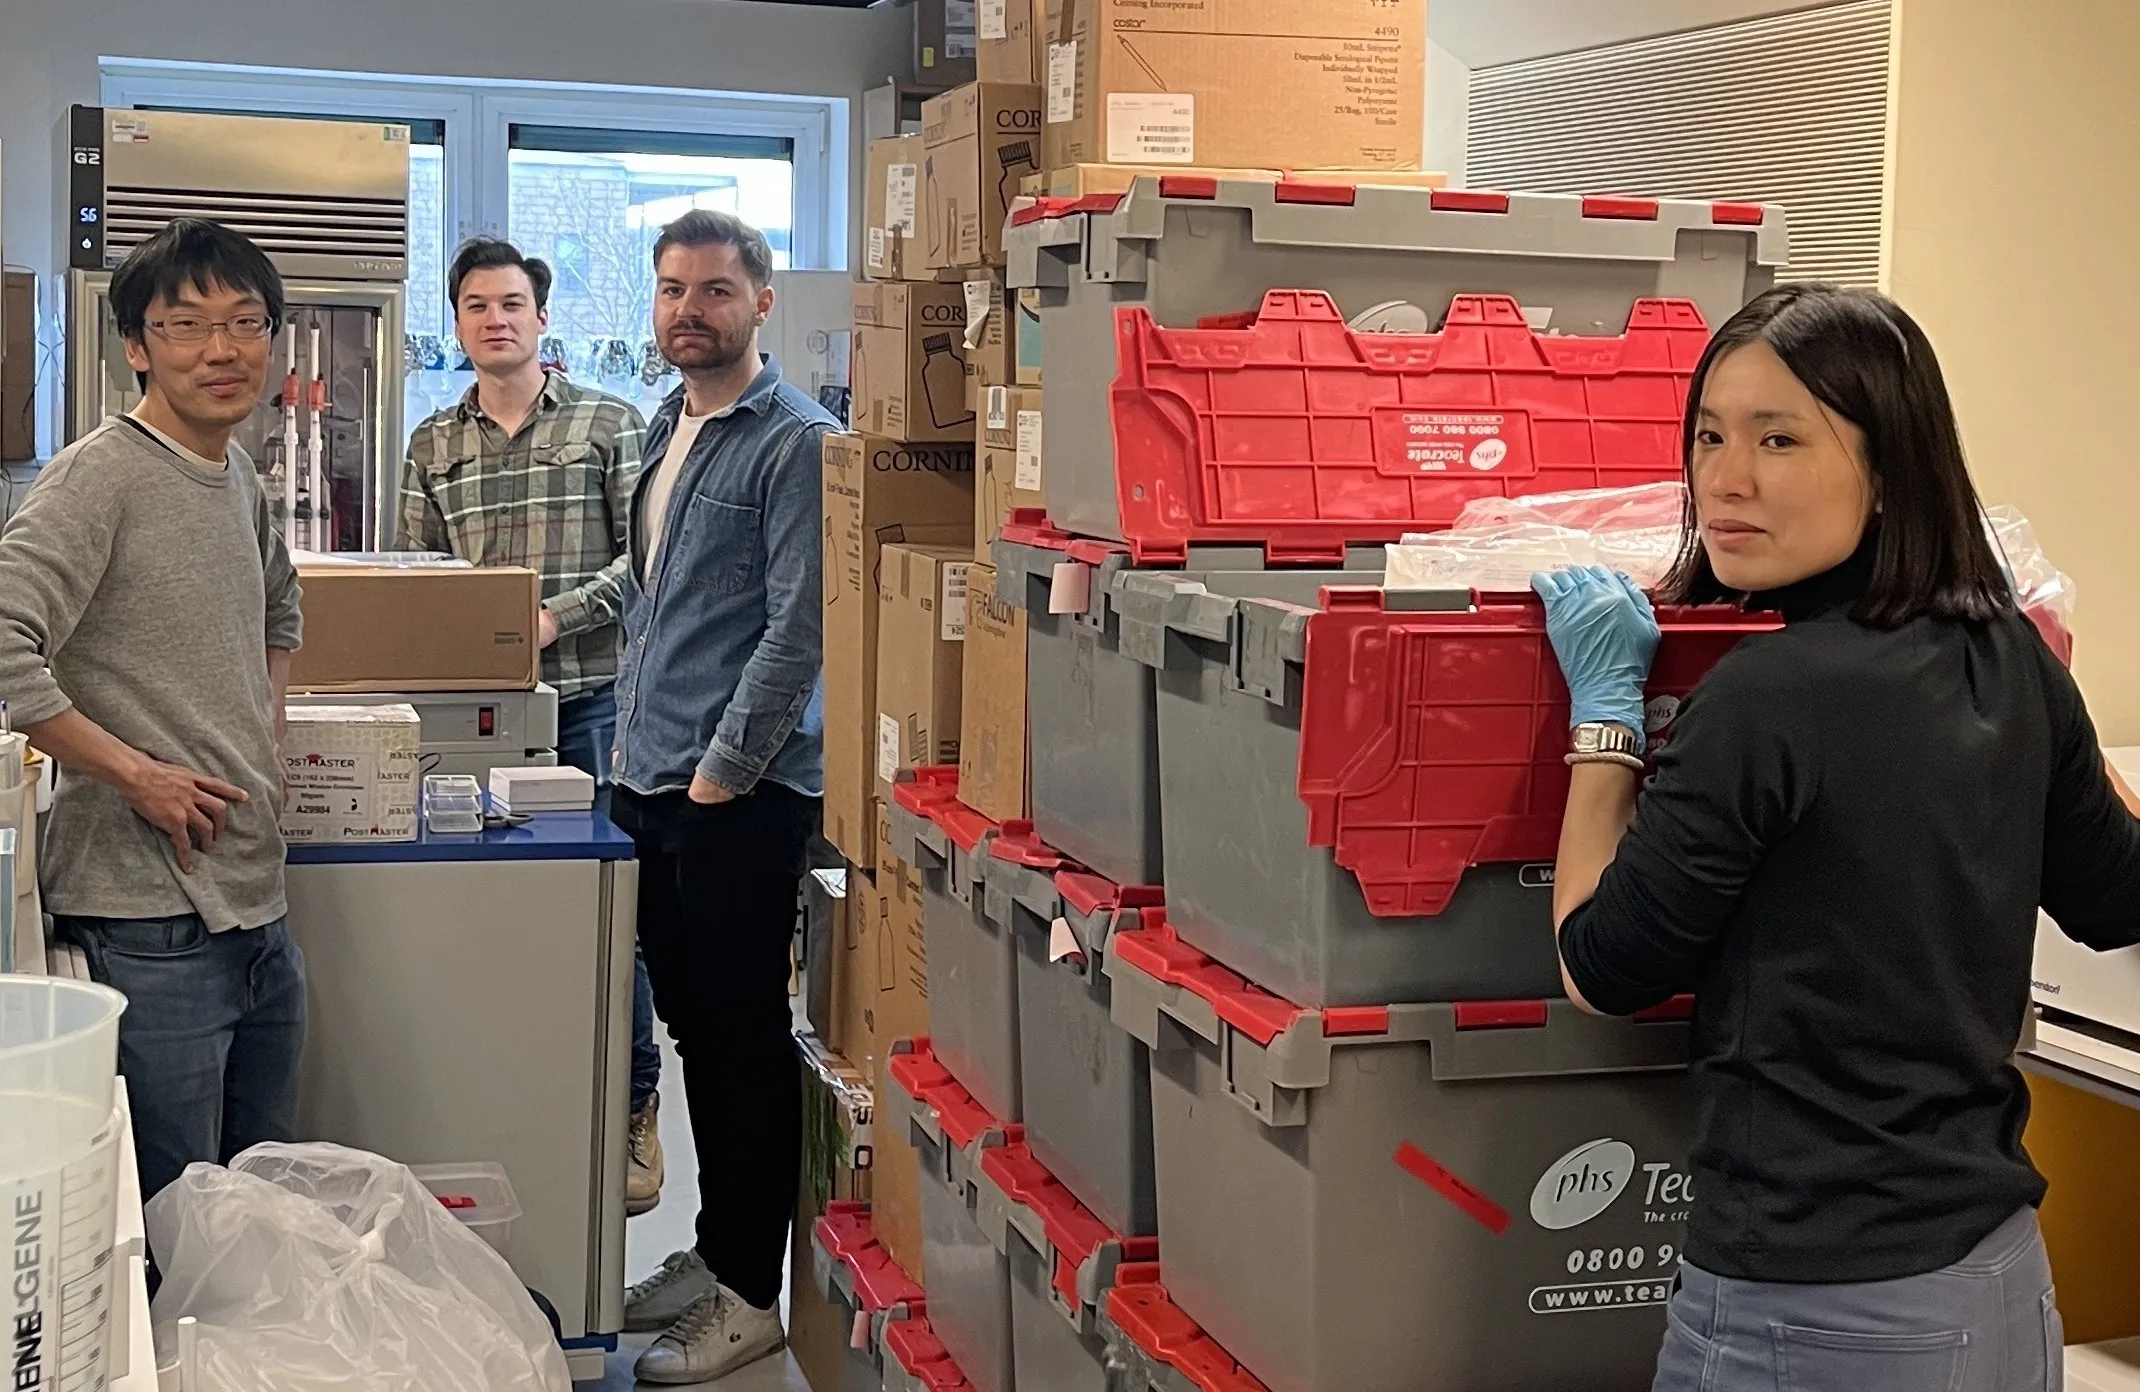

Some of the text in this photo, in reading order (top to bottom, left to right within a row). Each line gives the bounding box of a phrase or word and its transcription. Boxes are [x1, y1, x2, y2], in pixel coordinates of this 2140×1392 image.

[1374, 26, 1399, 37] 4490
[1322, 64, 1398, 75] Individually Wrapped
[74, 153, 100, 165] G2
[1553, 1163, 1615, 1204] phs
[1644, 1211, 1665, 1223] The
[1566, 1246, 1645, 1275] 0800
